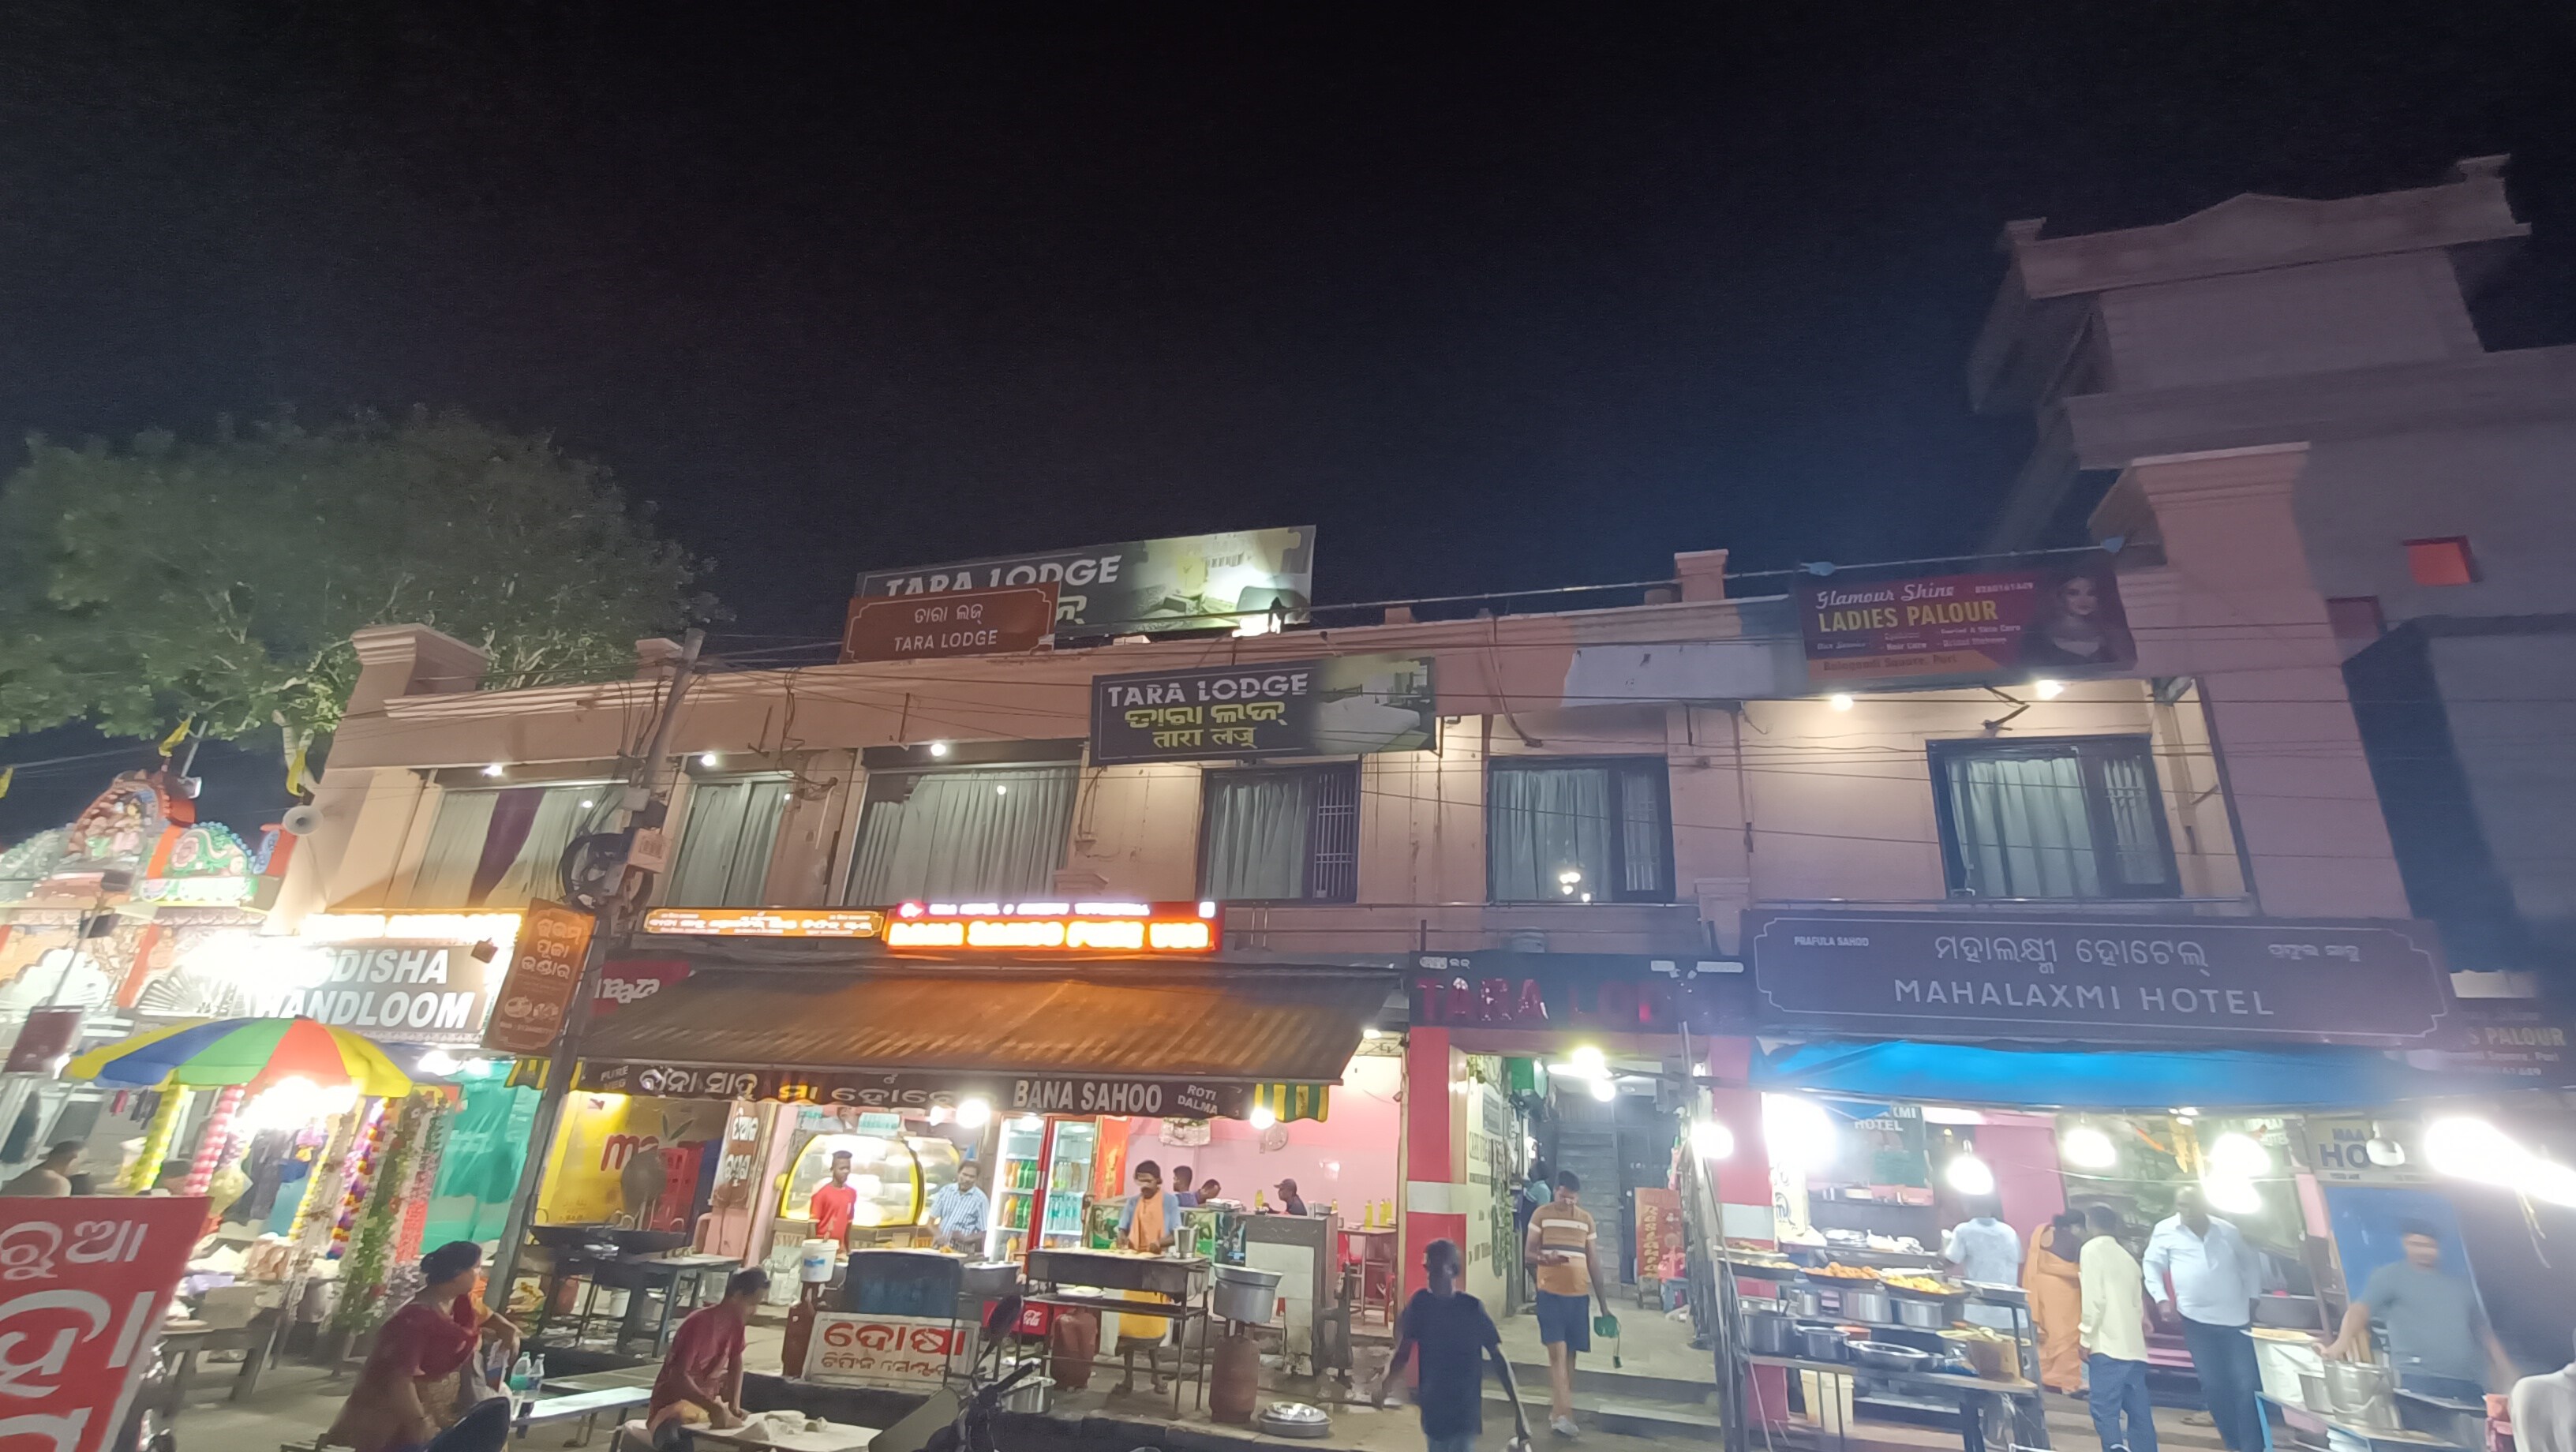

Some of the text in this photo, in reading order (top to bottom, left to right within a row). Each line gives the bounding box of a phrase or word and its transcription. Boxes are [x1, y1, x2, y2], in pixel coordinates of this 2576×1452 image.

[1816, 590, 1894, 609] Glamour
[1901, 582, 1954, 601] Shine
[915, 608, 948, 623] ତାରା
[1818, 600, 1998, 632] LADIES PALOUR
[894, 630, 998, 652] TARA LODGE
[1108, 673, 1309, 707] TARA LODGE
[1125, 702, 1288, 728] ତାରା ଲଜ୍
[1152, 728, 1204, 748] तारा
[1895, 979, 2275, 1016] MAHALAXMI HOTEL
[1013, 1080, 1163, 1113] BANA SAHOO
[1178, 1095, 1219, 1115] DALMA
[1187, 1084, 1217, 1102] ROTI
[1855, 1117, 1904, 1132] HOTEL
